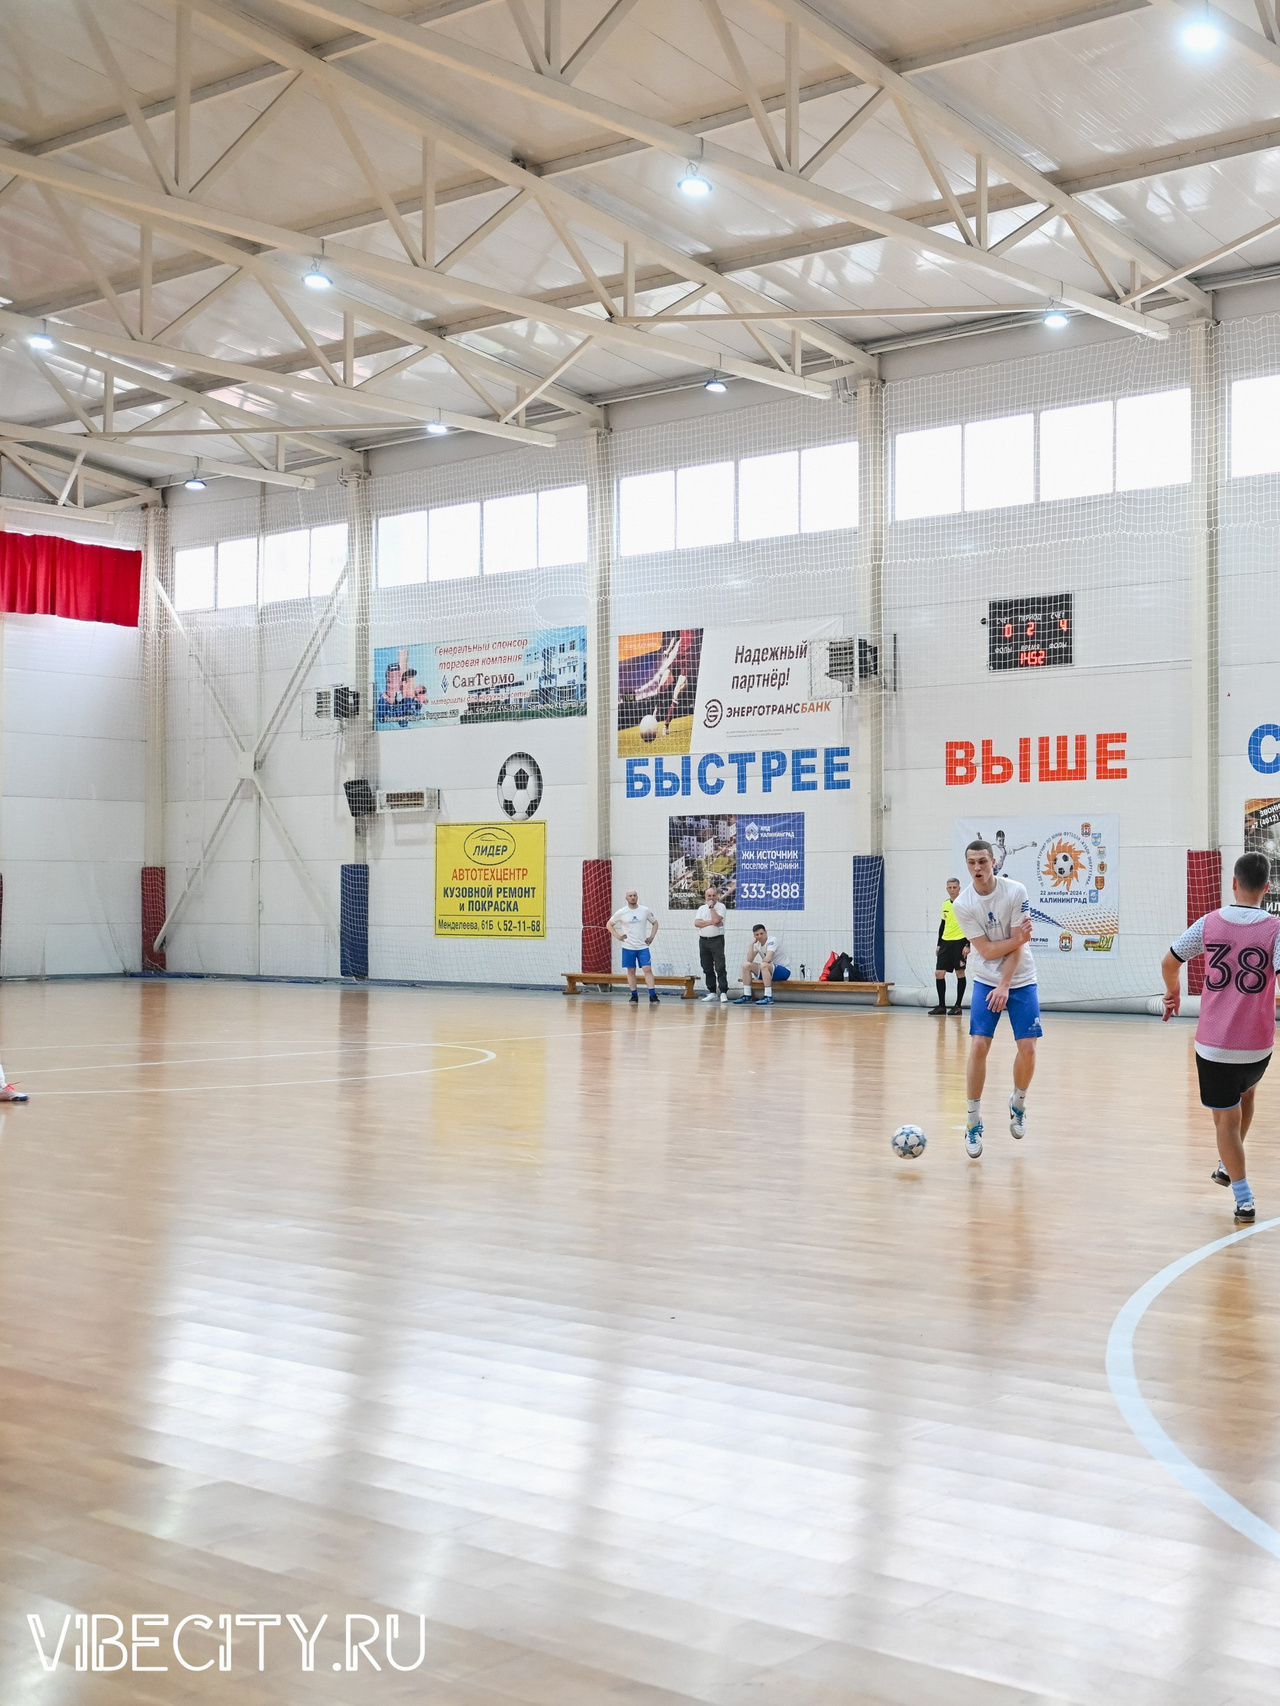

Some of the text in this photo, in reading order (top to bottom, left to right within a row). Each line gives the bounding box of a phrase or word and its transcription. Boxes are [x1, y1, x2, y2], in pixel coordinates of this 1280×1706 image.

[1018, 613, 1042, 622] ПЕРИОД
[1004, 619, 1068, 638] 0 2 4
[492, 639, 528, 650] спонсор
[1020, 644, 1041, 652] ВРЕМЯ
[735, 640, 808, 664] Надежный
[438, 654, 523, 671] торговая компания
[452, 672, 515, 689] СанТермо
[731, 668, 790, 692] партнёр!
[726, 701, 831, 718] ЭНЕРГОТРАНСБАНК
[945, 732, 1128, 786] ВЫШЕ
[626, 747, 850, 798] БЫСТРЕЕ
[1260, 814, 1279, 828] (4012)
[473, 845, 508, 857] ЛИДЕР
[741, 850, 799, 860] ЖК ИСТОЧНИК
[741, 860, 799, 870] поселок Родники
[451, 868, 528, 882] АВТОТЕХЦЕНТР
[443, 885, 536, 898] КУЗОВНОЙ РЕМОНТ
[740, 883, 800, 899] 333-888
[1047, 889, 1069, 897] декабря
[459, 900, 519, 912] и ПОКРАСКА
[1039, 897, 1088, 905] КАЛИНИНГРАД
[438, 919, 541, 932] Менделеева, 61Б 52-11-68
[1205, 944, 1269, 995] 38
